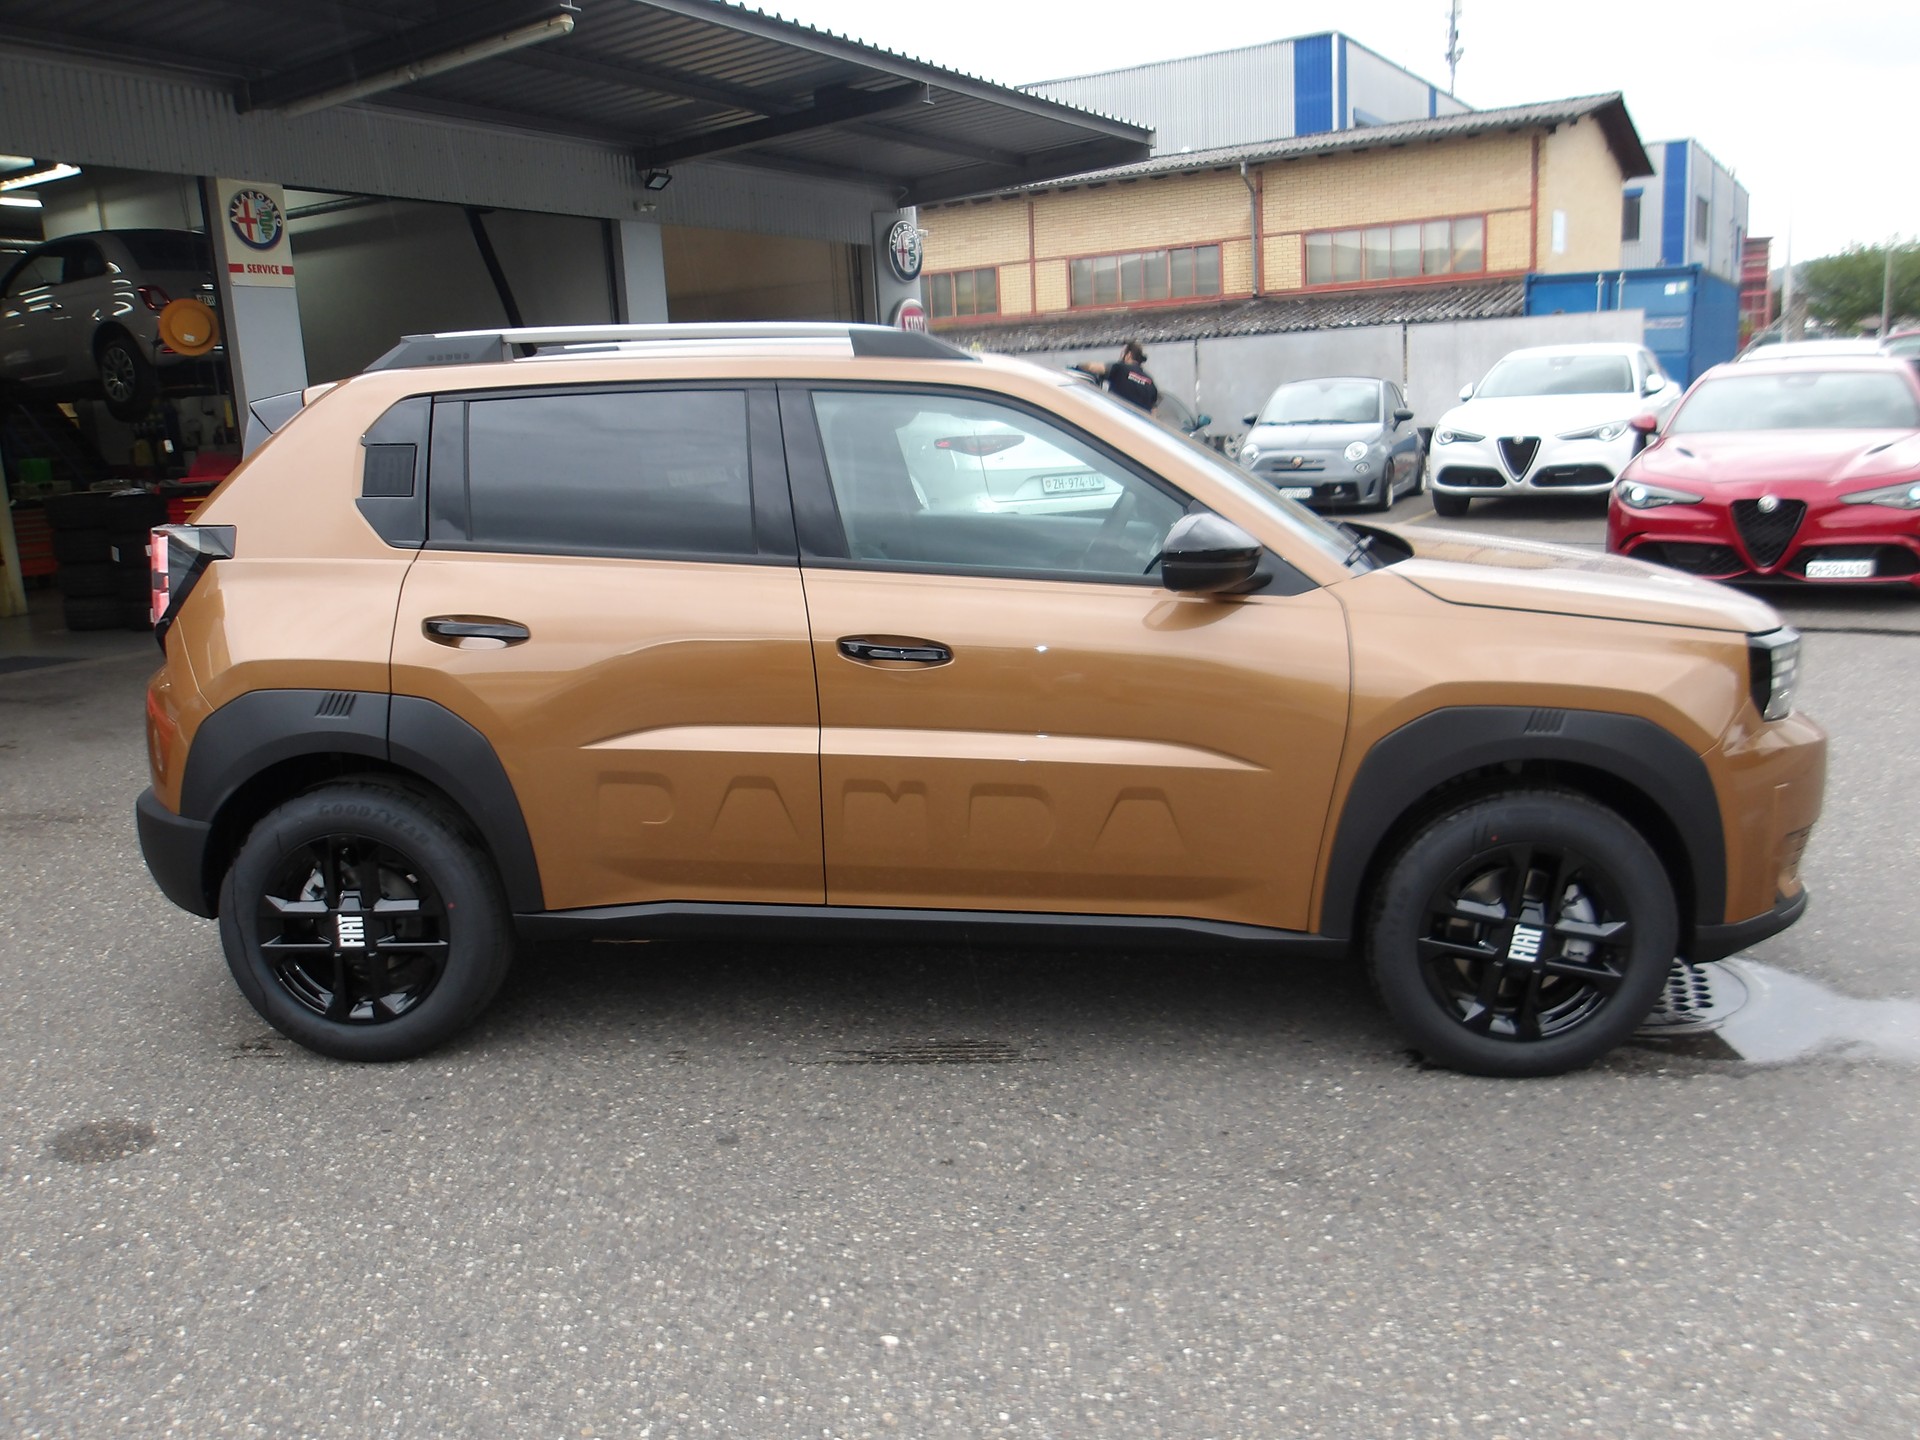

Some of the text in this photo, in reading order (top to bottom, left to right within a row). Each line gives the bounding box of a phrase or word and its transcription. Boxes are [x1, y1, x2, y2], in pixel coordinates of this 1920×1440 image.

[247, 264, 280, 274] SERVICE
[337, 913, 365, 947] FIAT
[1507, 924, 1543, 962] FIAT
